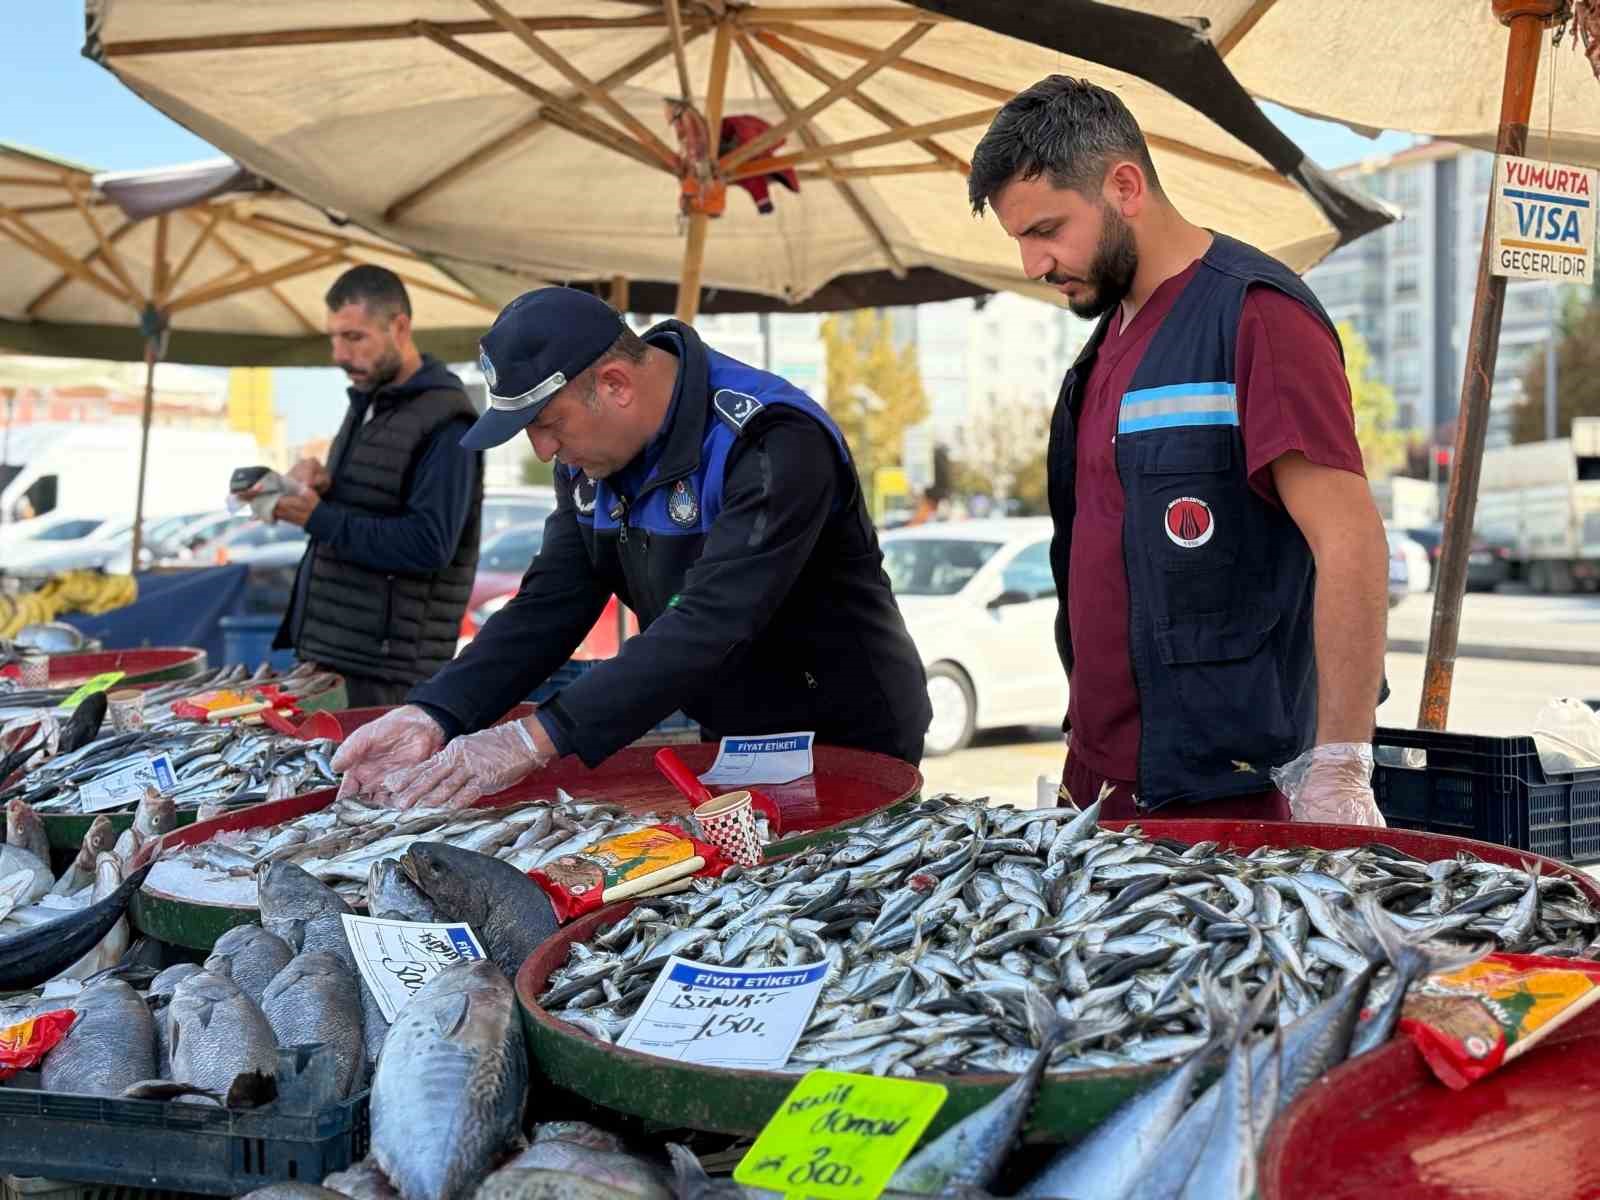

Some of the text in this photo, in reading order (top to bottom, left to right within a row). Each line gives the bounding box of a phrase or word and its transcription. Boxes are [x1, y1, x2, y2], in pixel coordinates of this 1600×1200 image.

[1505, 161, 1590, 195] YUMURTA
[1512, 201, 1580, 243] VISA
[1501, 250, 1586, 277] GEÇERLİDİR
[738, 738, 797, 753] FİYAT ETİKETİ
[694, 971, 808, 988] FİYAT ETİKETİ
